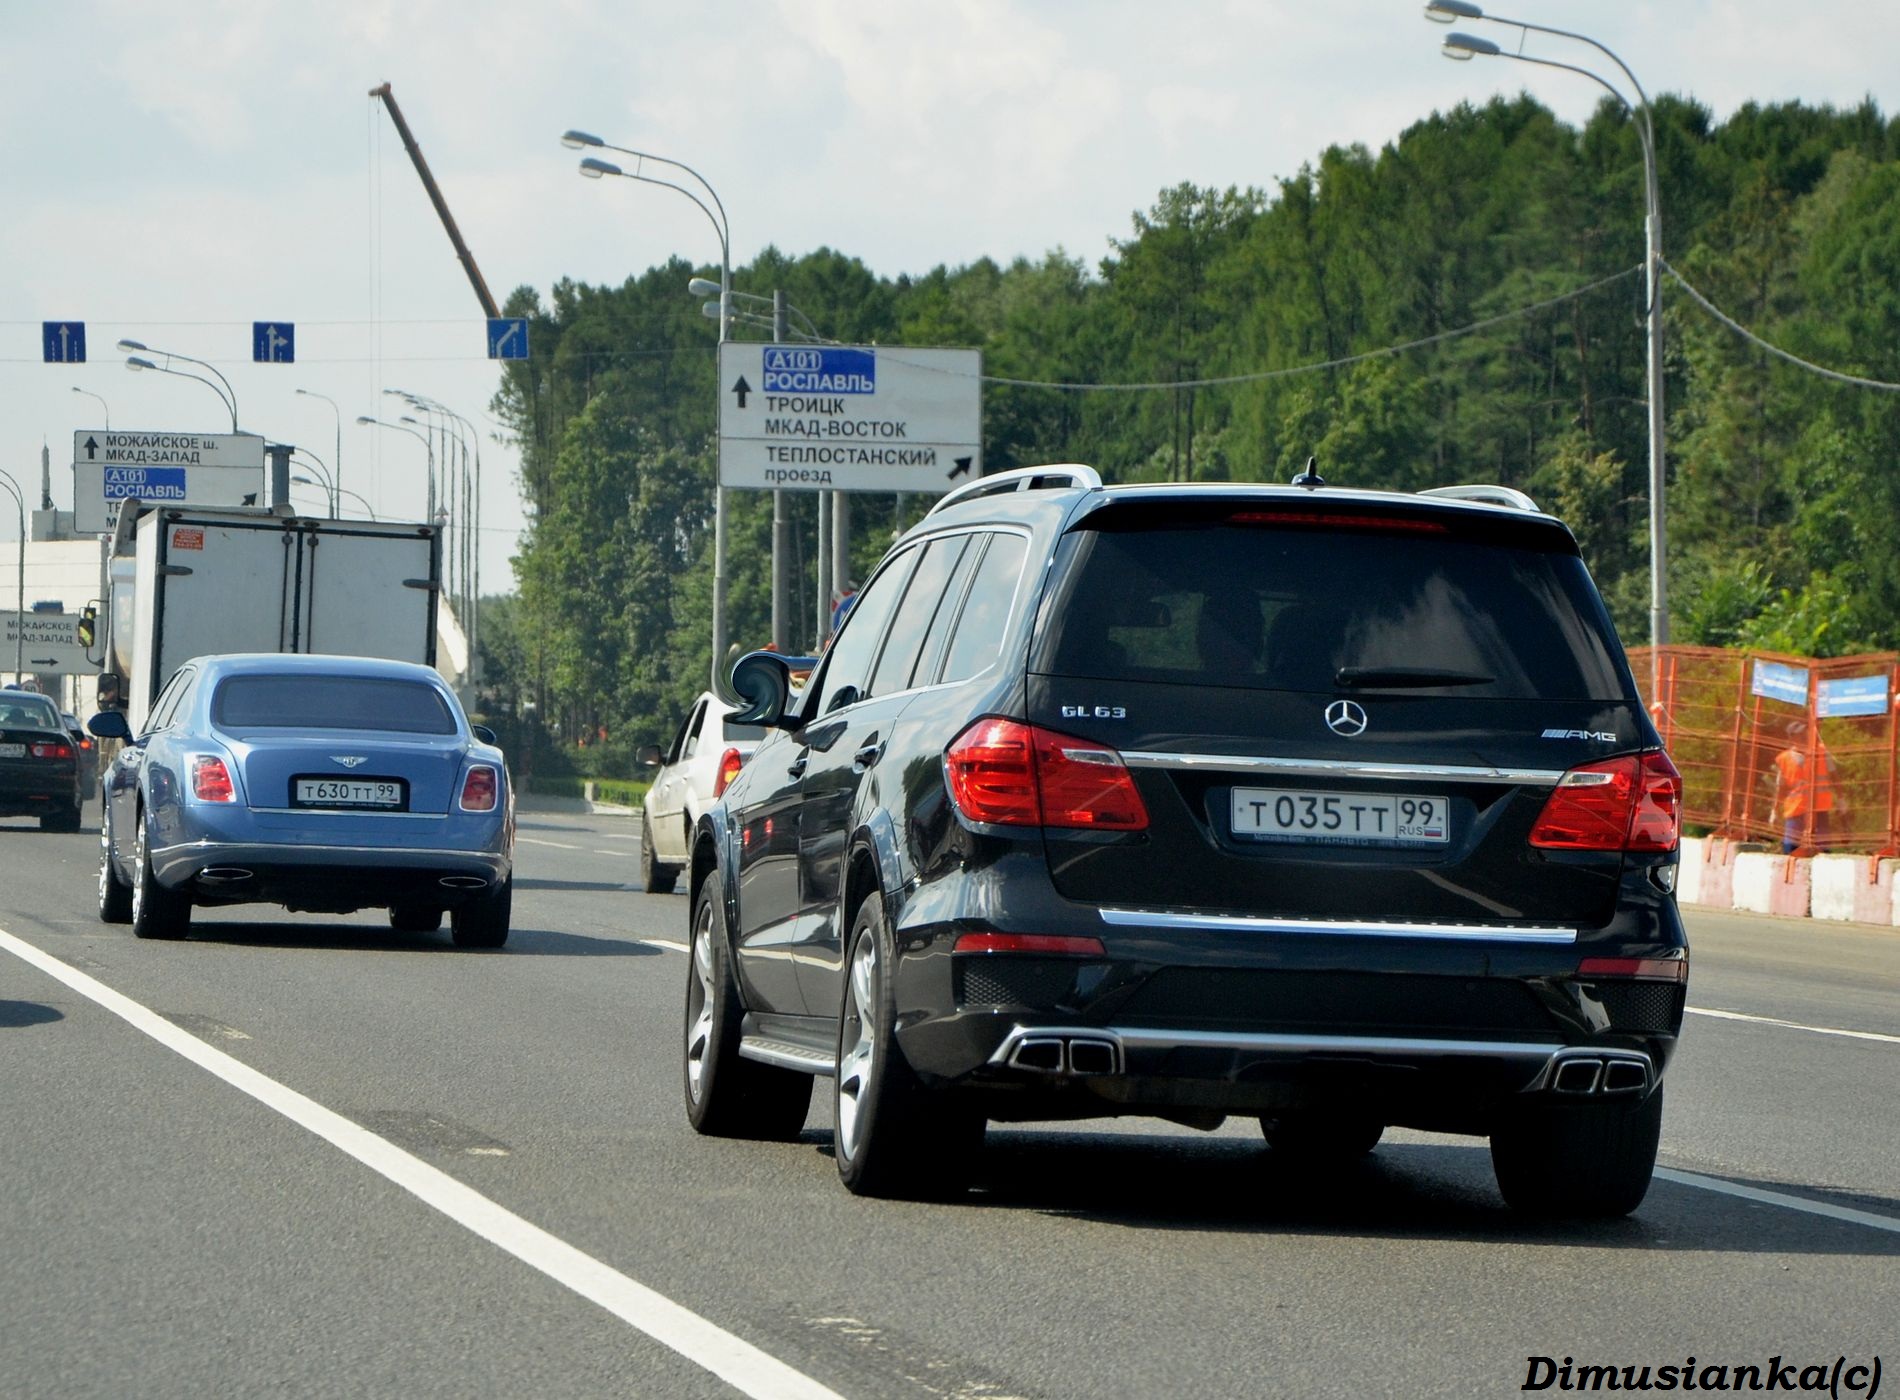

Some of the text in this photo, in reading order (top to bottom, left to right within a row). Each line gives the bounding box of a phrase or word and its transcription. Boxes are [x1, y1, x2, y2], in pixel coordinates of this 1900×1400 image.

[764, 373, 874, 392] РОСЛАВЛЬ
[766, 397, 844, 416] ТРОИЦК
[765, 419, 907, 438] МКАД-ВОСТОК
[106, 434, 219, 450] МОЖАЙСКОЕ ш.
[105, 449, 200, 464] МКАД-ЗАПАД
[766, 446, 936, 466] ТЕПЛОСТАНСКИЙ
[765, 469, 832, 484] проезд
[105, 484, 185, 498] РОСЛАВЛЬ
[7, 620, 73, 631] МЖАЙСКОЕ
[7, 633, 73, 644] МАД-ЗАПАД
[1062, 705, 1126, 718] GL 63
[1566, 730, 1617, 742] AMG
[377, 784, 394, 796] 99
[1401, 799, 1434, 825] 99
[1399, 825, 1423, 836] RUS
